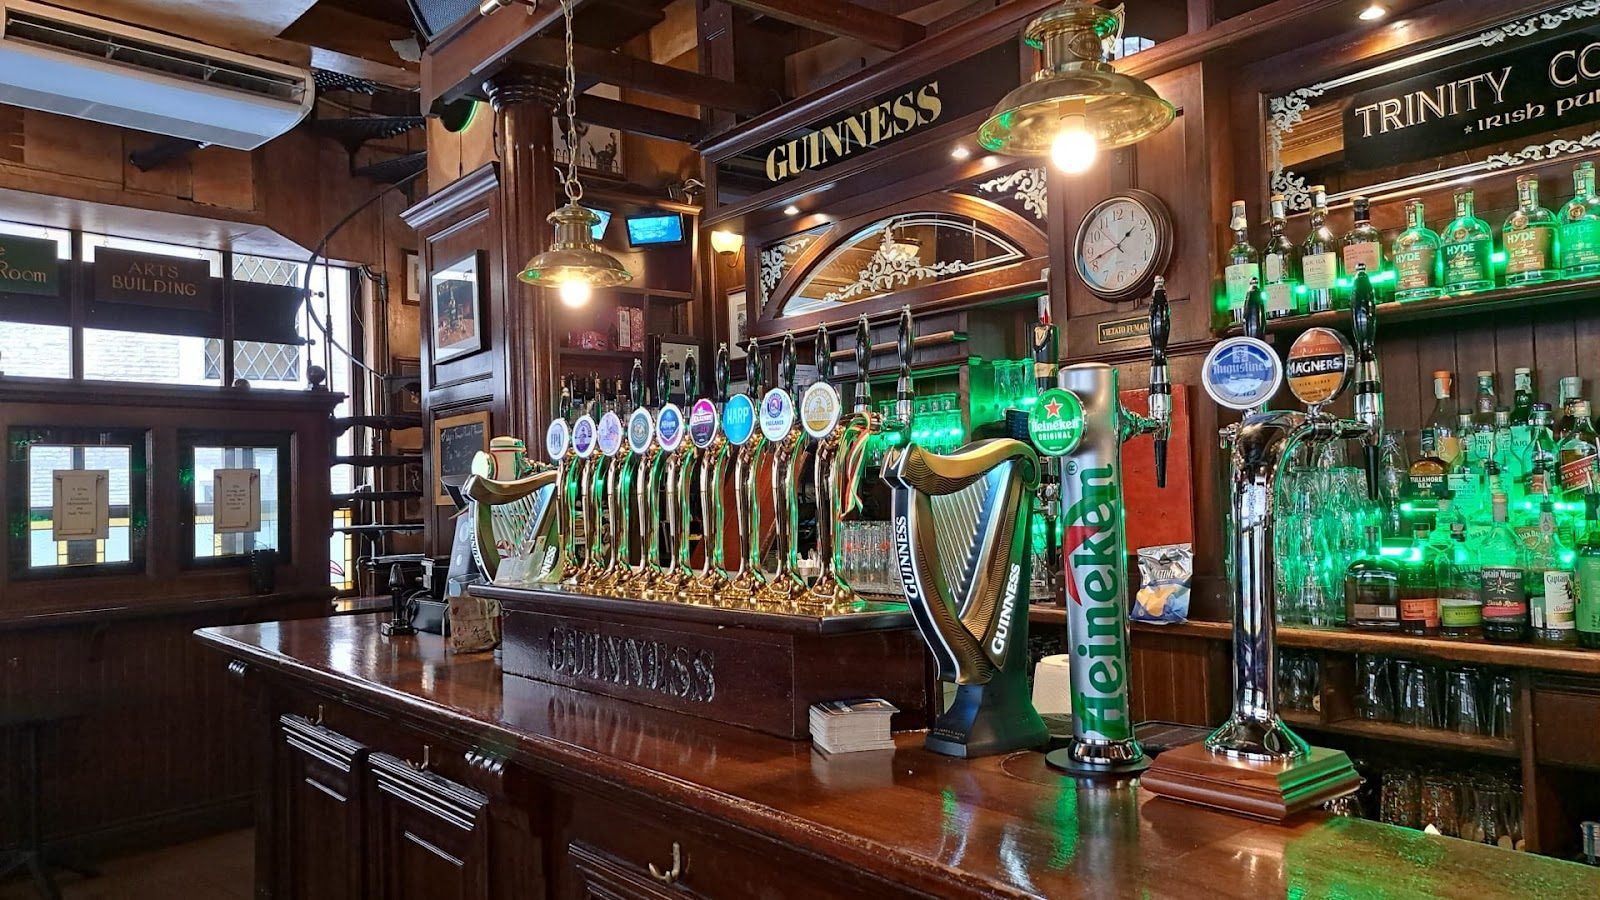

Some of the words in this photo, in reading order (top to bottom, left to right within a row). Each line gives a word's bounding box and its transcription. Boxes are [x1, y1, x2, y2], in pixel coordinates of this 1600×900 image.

[1355, 66, 1513, 138] TRINITY
[765, 80, 942, 182] GUINNESS
[1112, 208, 1124, 221] 12
[1139, 218, 1148, 231] 2
[1089, 230, 1101, 243] 10
[1507, 230, 1536, 244] HYDE
[1395, 252, 1421, 263] HYDE
[1446, 243, 1475, 255] HYDE
[128, 262, 179, 279] ARTS
[112, 274, 197, 296] BUILDING
[1126, 322, 1149, 333] FUMAR
[1287, 357, 1342, 376] MAGNERS
[726, 406, 750, 425] HARP
[1031, 417, 1081, 433] Heineken
[1038, 431, 1073, 441] ORIGINAL
[895, 515, 919, 599] GUINNESS
[991, 563, 1021, 655] GUINNESS
[1074, 464, 1126, 737] Heineken
[549, 627, 716, 703] GUINNESS
